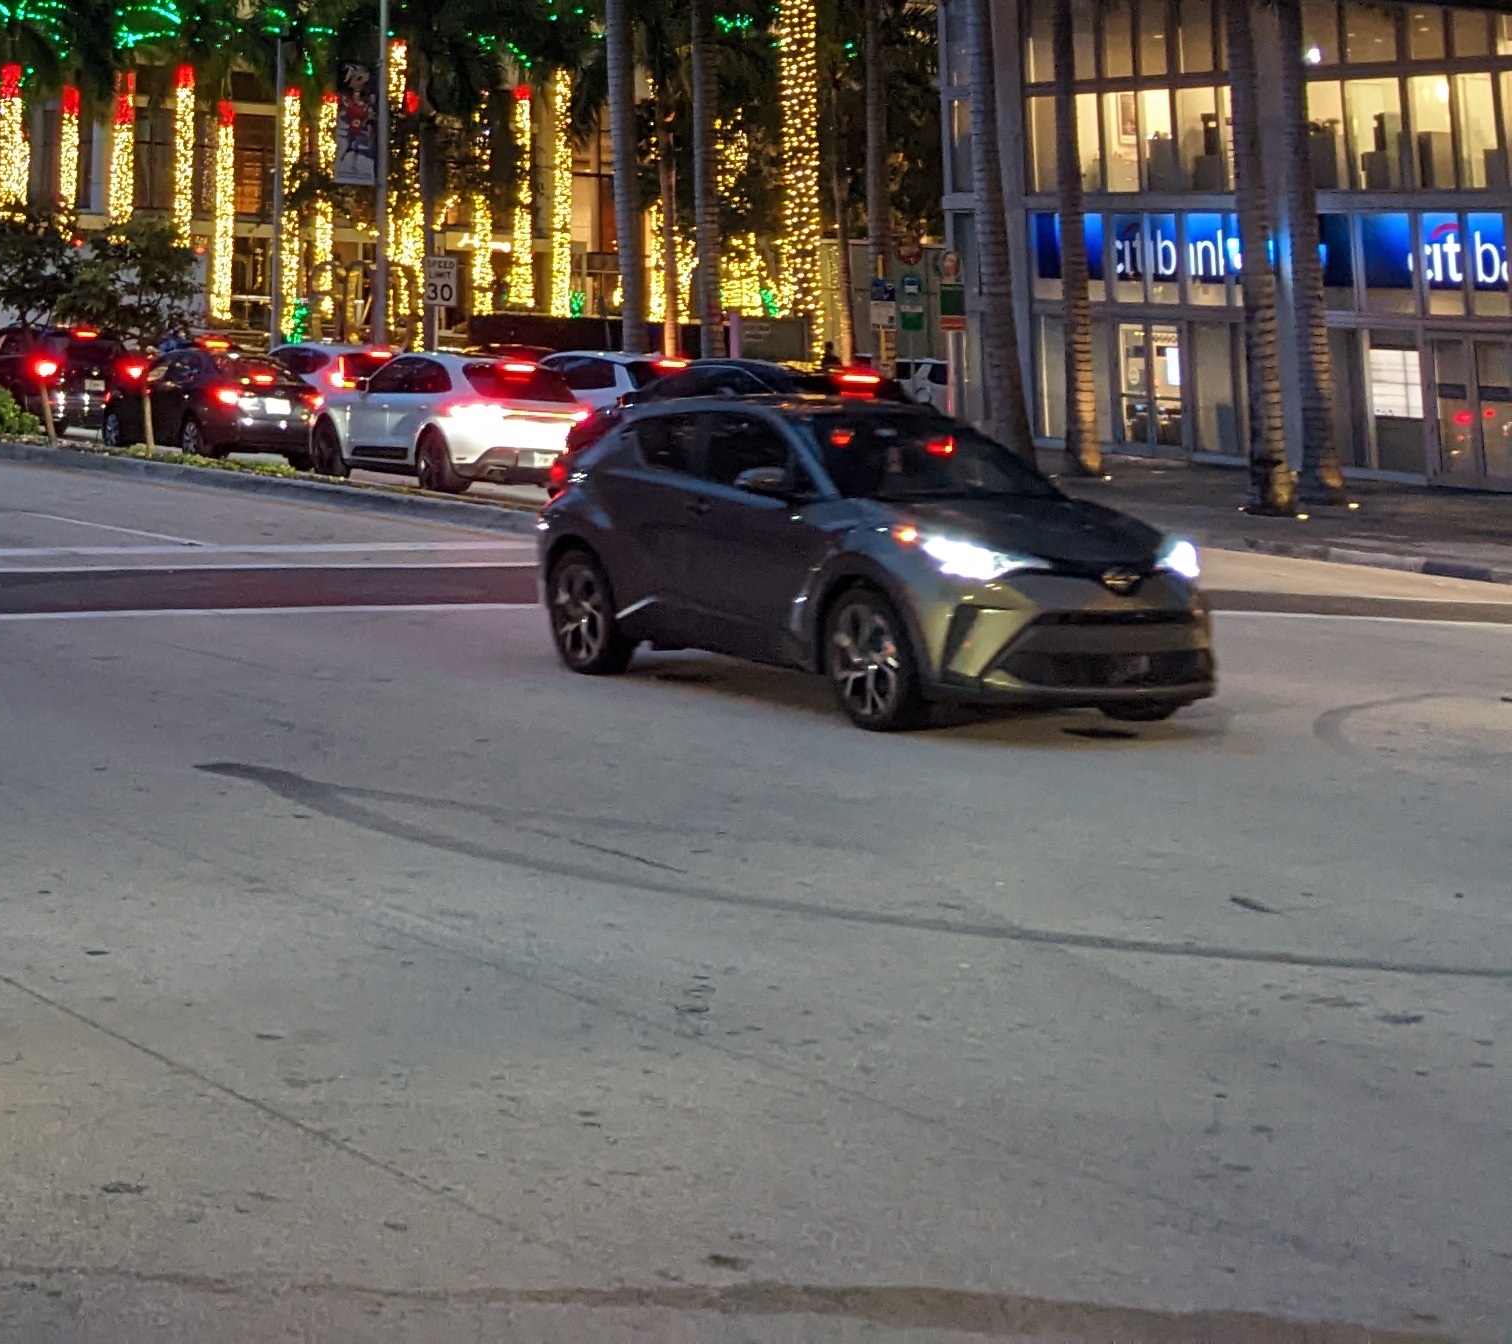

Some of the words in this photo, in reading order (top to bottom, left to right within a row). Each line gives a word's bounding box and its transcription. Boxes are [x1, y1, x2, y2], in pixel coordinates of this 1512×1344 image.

[427, 260, 455, 269] SPEED
[429, 271, 451, 279] LIMIT
[427, 283, 453, 302] 30
